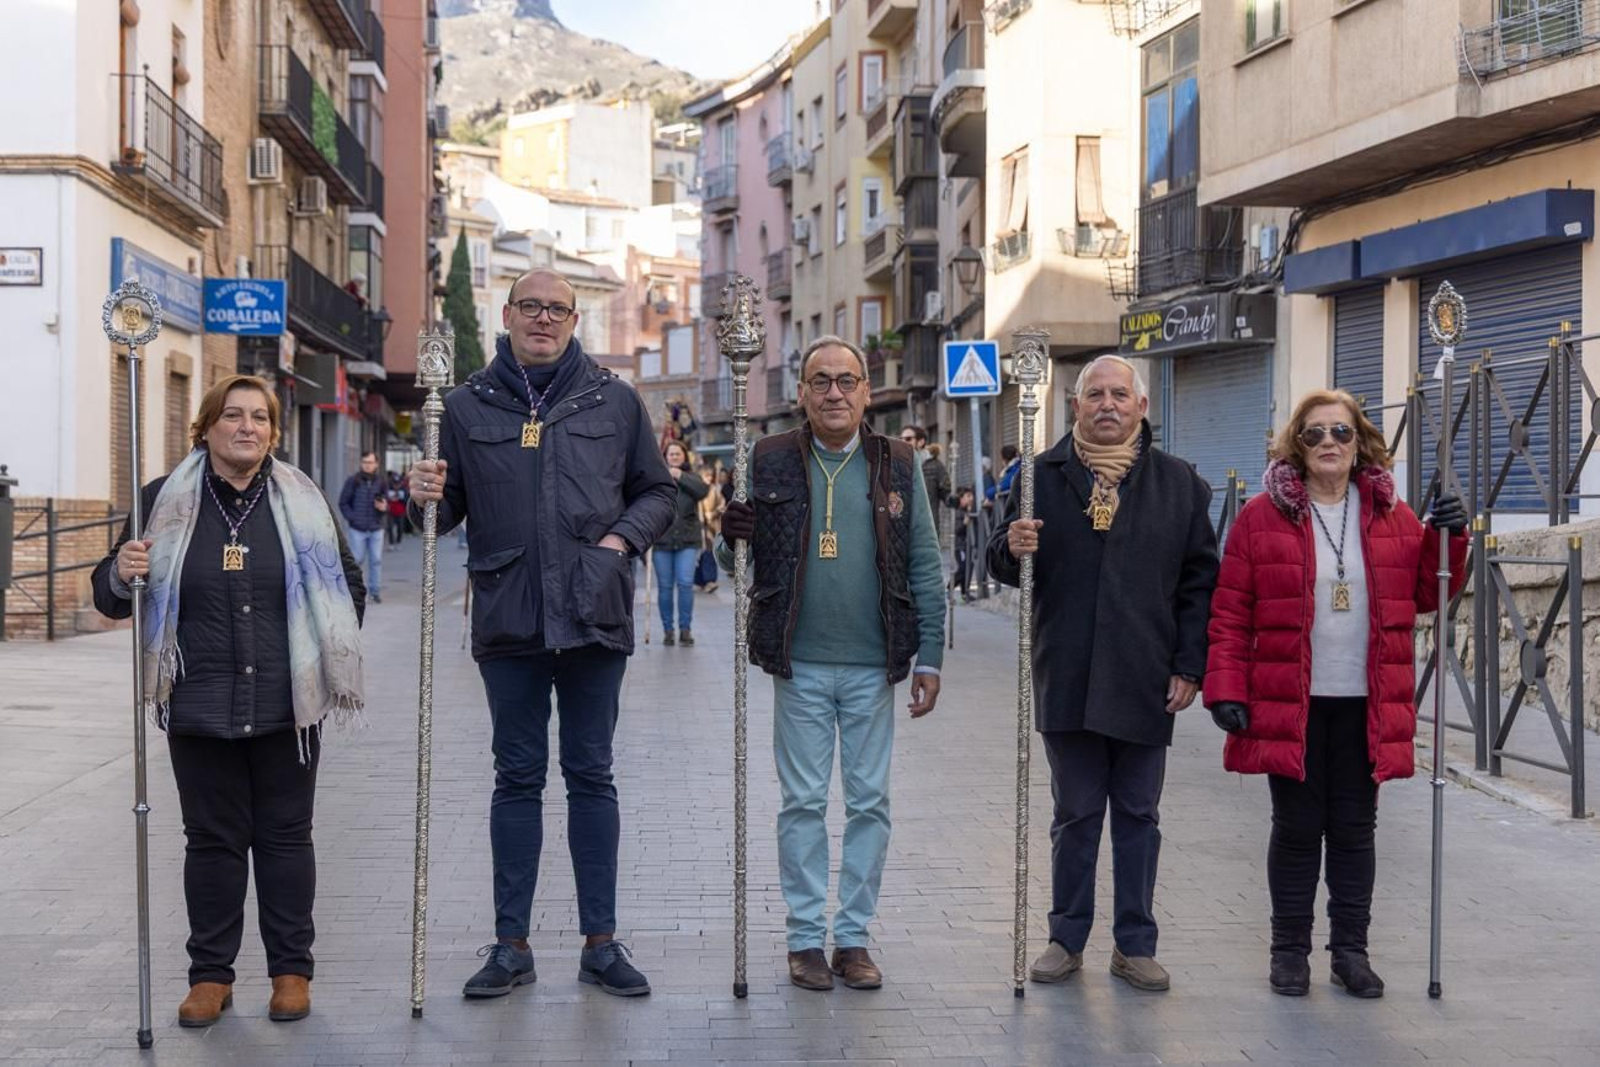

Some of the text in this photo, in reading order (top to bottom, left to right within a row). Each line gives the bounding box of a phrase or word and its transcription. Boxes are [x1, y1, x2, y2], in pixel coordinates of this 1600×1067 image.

[207, 308, 281, 323] COBALEDA
[1122, 312, 1162, 333] CALZADOS
[1163, 305, 1216, 342] Candy
